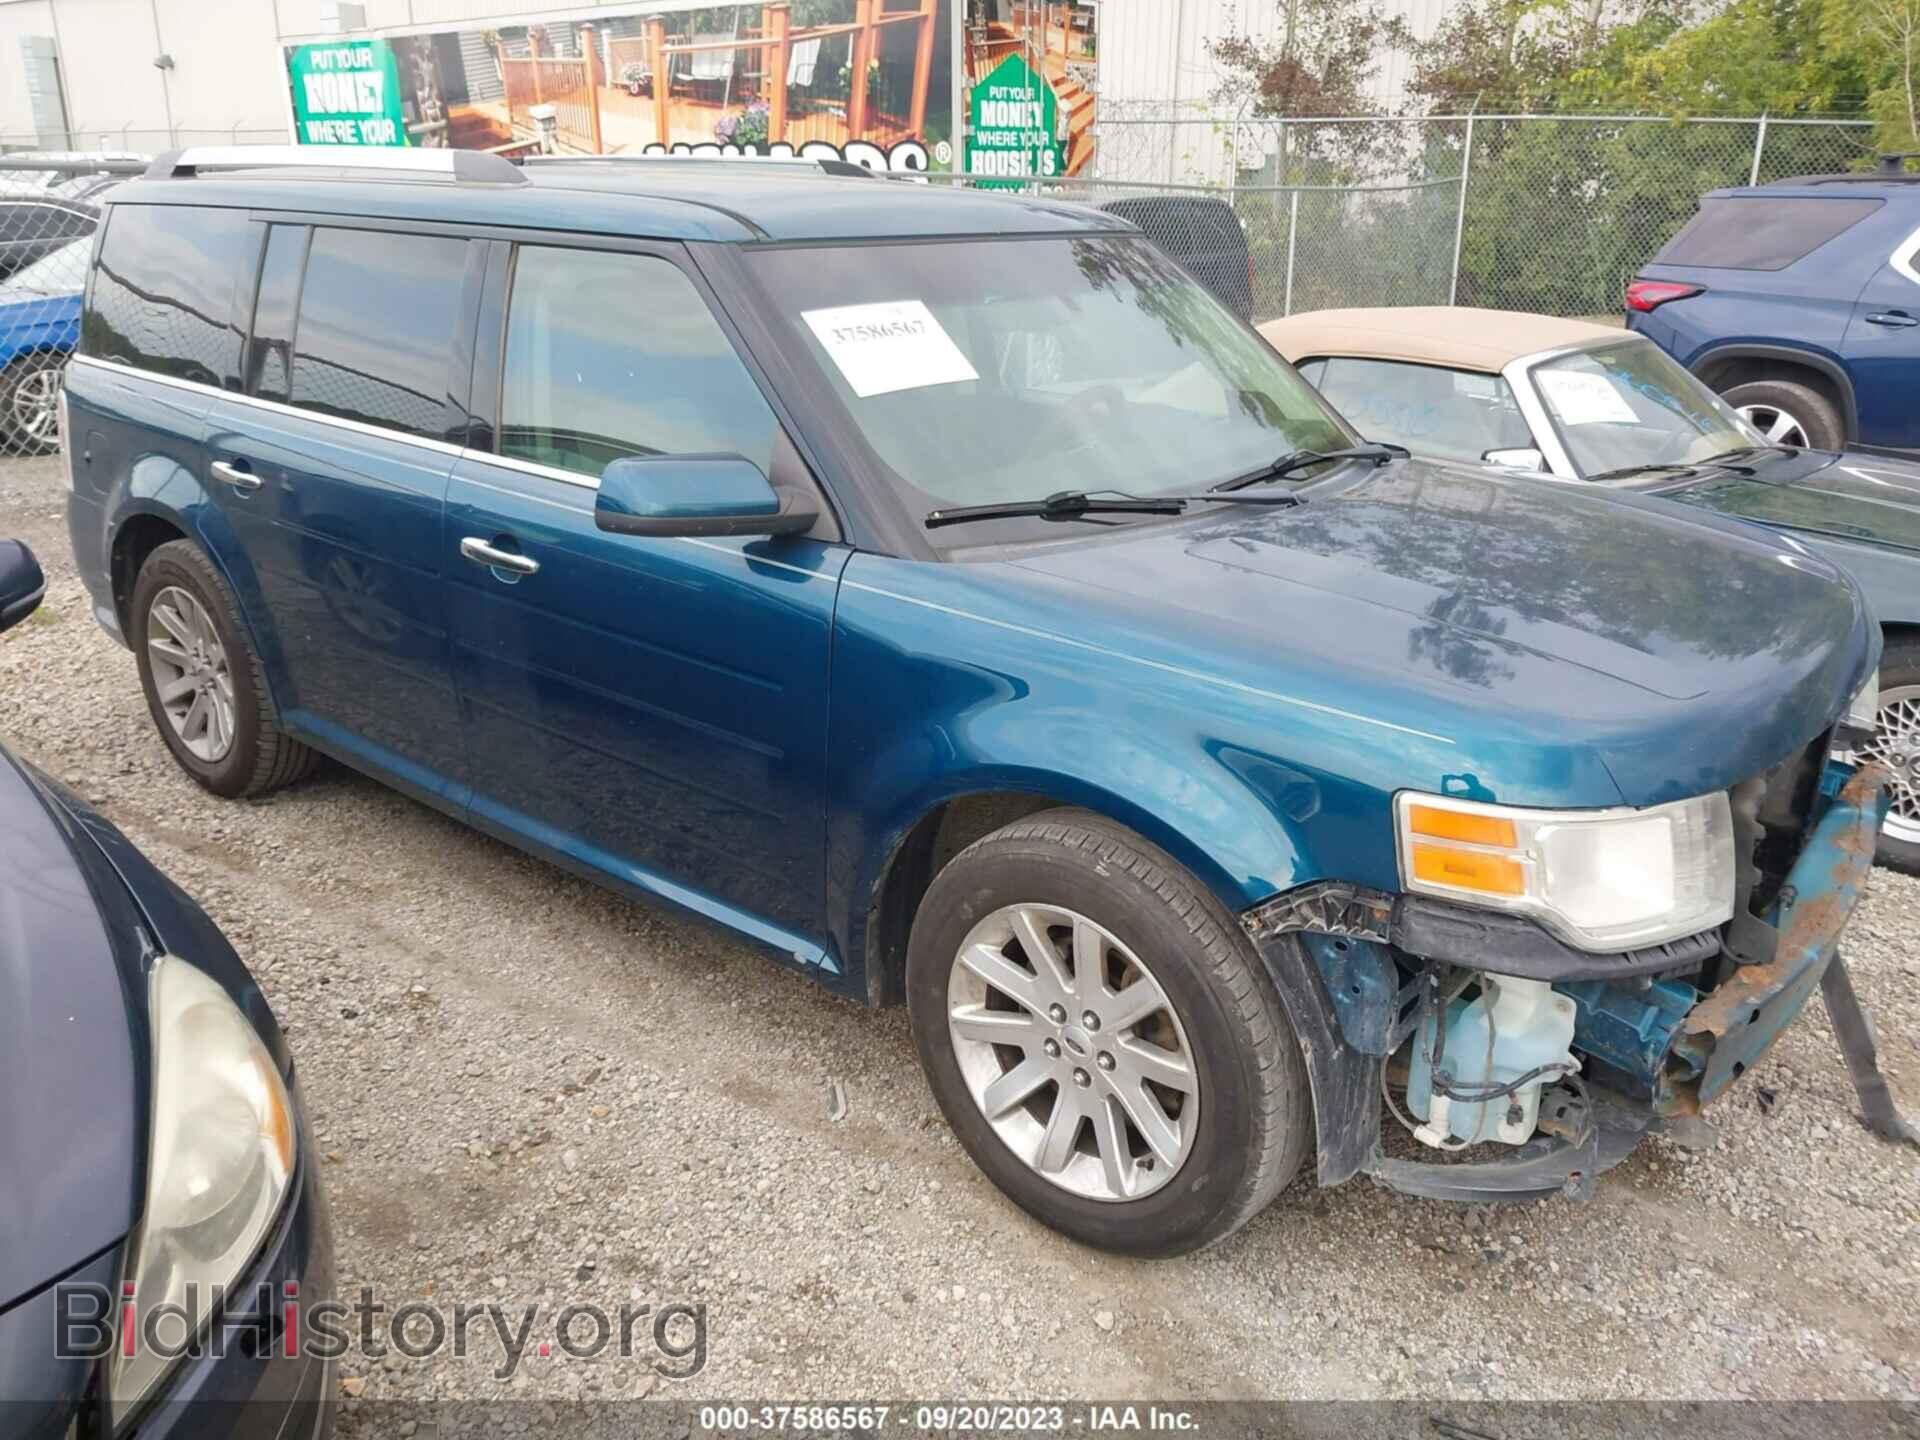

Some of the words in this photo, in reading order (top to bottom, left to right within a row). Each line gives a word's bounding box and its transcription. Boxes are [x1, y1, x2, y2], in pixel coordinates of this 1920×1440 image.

[311, 50, 334, 69] PUT
[334, 48, 373, 68] YOUR
[303, 71, 384, 113] MONEY
[989, 85, 1008, 99] PUT
[1008, 86, 1035, 100] YOUR
[980, 100, 1043, 127] MONEY
[305, 120, 358, 144] WHERE
[357, 118, 396, 143] YOUR
[976, 130, 1018, 146] WHERE
[1019, 130, 1050, 146] YOUR
[971, 149, 1033, 176] HOUSE
[1034, 148, 1056, 176] IS
[831, 320, 926, 344] 37586567
